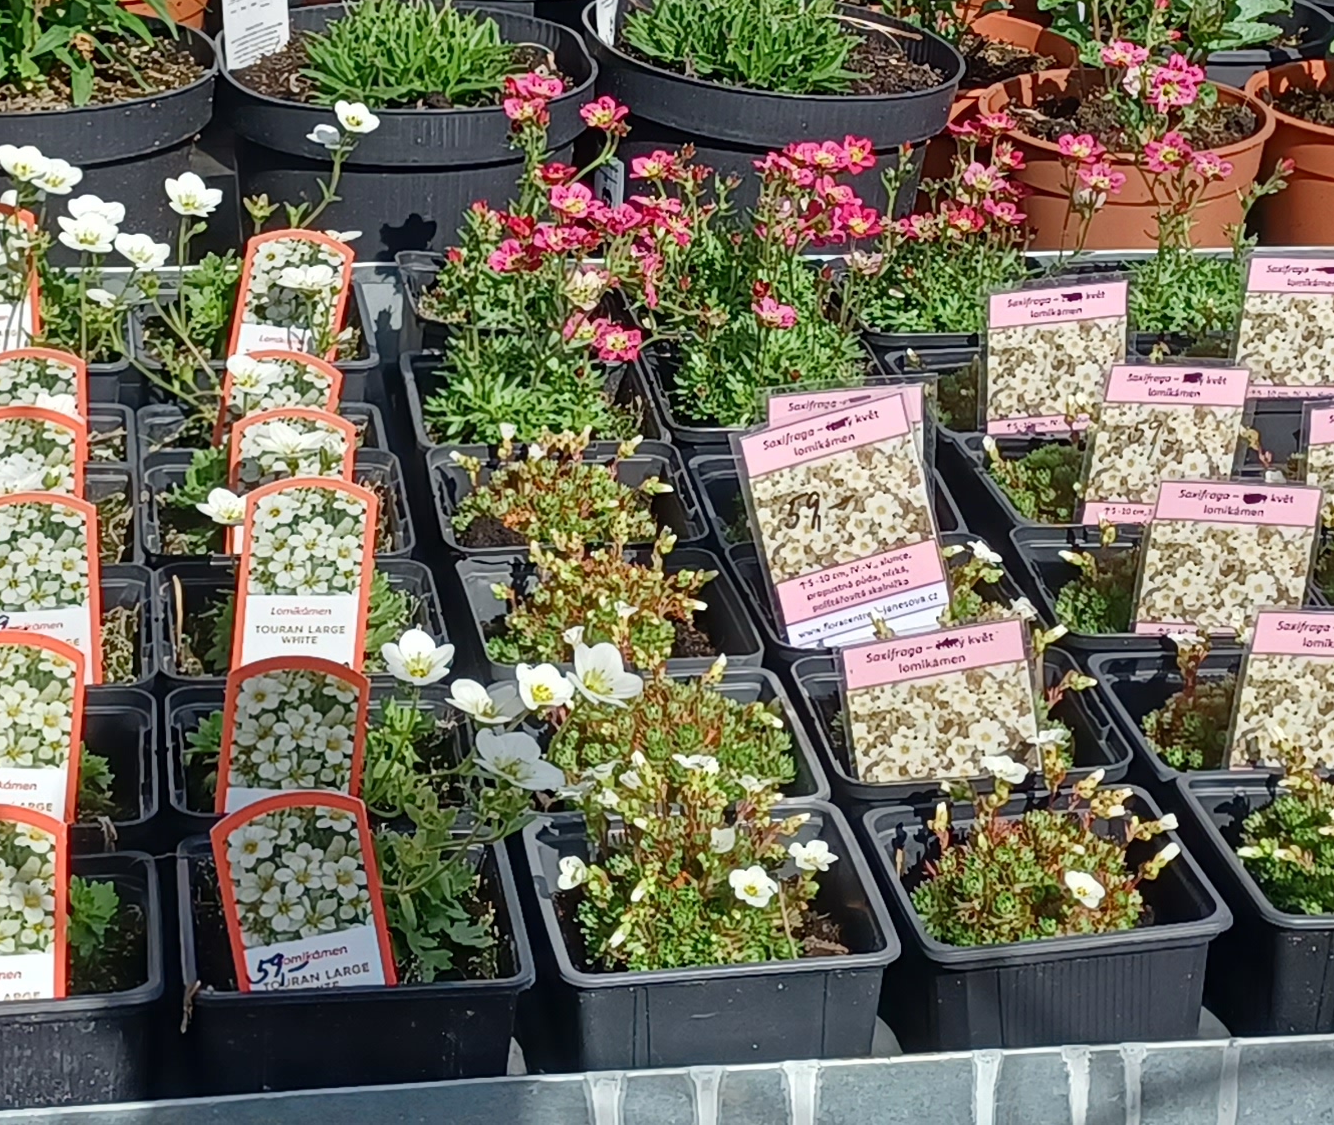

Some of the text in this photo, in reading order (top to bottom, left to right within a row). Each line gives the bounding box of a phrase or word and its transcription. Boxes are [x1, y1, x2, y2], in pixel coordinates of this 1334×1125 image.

[763, 427, 815, 452] Saxifraga
[854, 409, 880, 424] květ
[793, 433, 856, 457] lomikámen
[1178, 489, 1230, 502] Saxifraga
[1203, 505, 1265, 517] lomikámen
[255, 625, 346, 634] TOURAN LARGE
[1276, 620, 1331, 634] Saxifraga
[281, 636, 318, 644] WHITE
[866, 646, 923, 663] Saxifraga
[968, 632, 994, 645] květ
[898, 654, 967, 674] lomikámen
[283, 945, 348, 966] omikámen
[325, 962, 370, 980] LARGE
